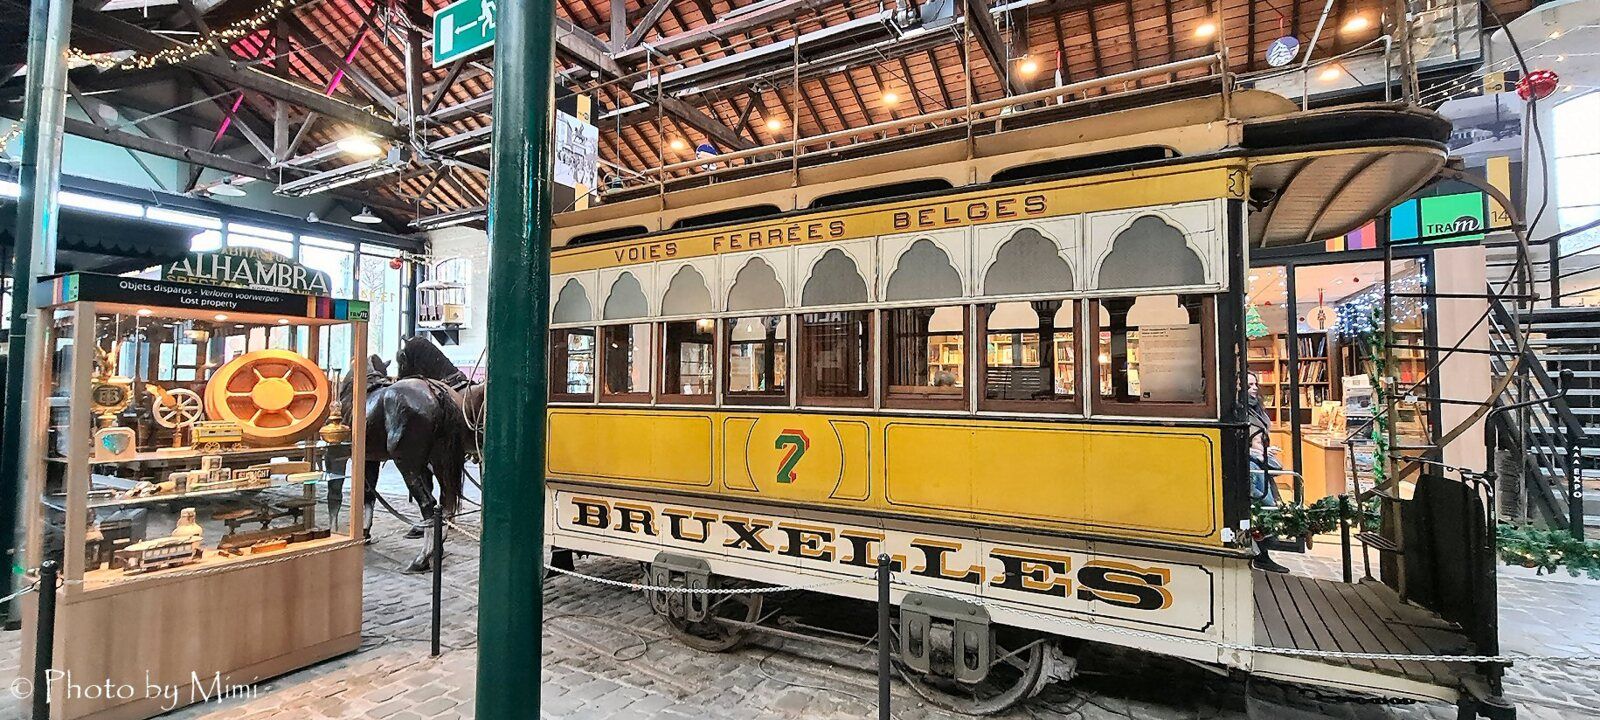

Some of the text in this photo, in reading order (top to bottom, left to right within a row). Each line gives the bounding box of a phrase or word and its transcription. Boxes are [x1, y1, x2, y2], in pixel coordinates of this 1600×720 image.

[615, 194, 1048, 262] VOIES FERRÉES BELGES
[119, 280, 151, 292] Objets
[153, 282, 192, 295] disparus
[200, 288, 233, 299] Verloren
[235, 292, 280, 303] voorwerpen
[167, 252, 329, 293] ALHAMBRA
[180, 296, 238, 309] Lost property
[571, 496, 1174, 611] BRUXELLES
